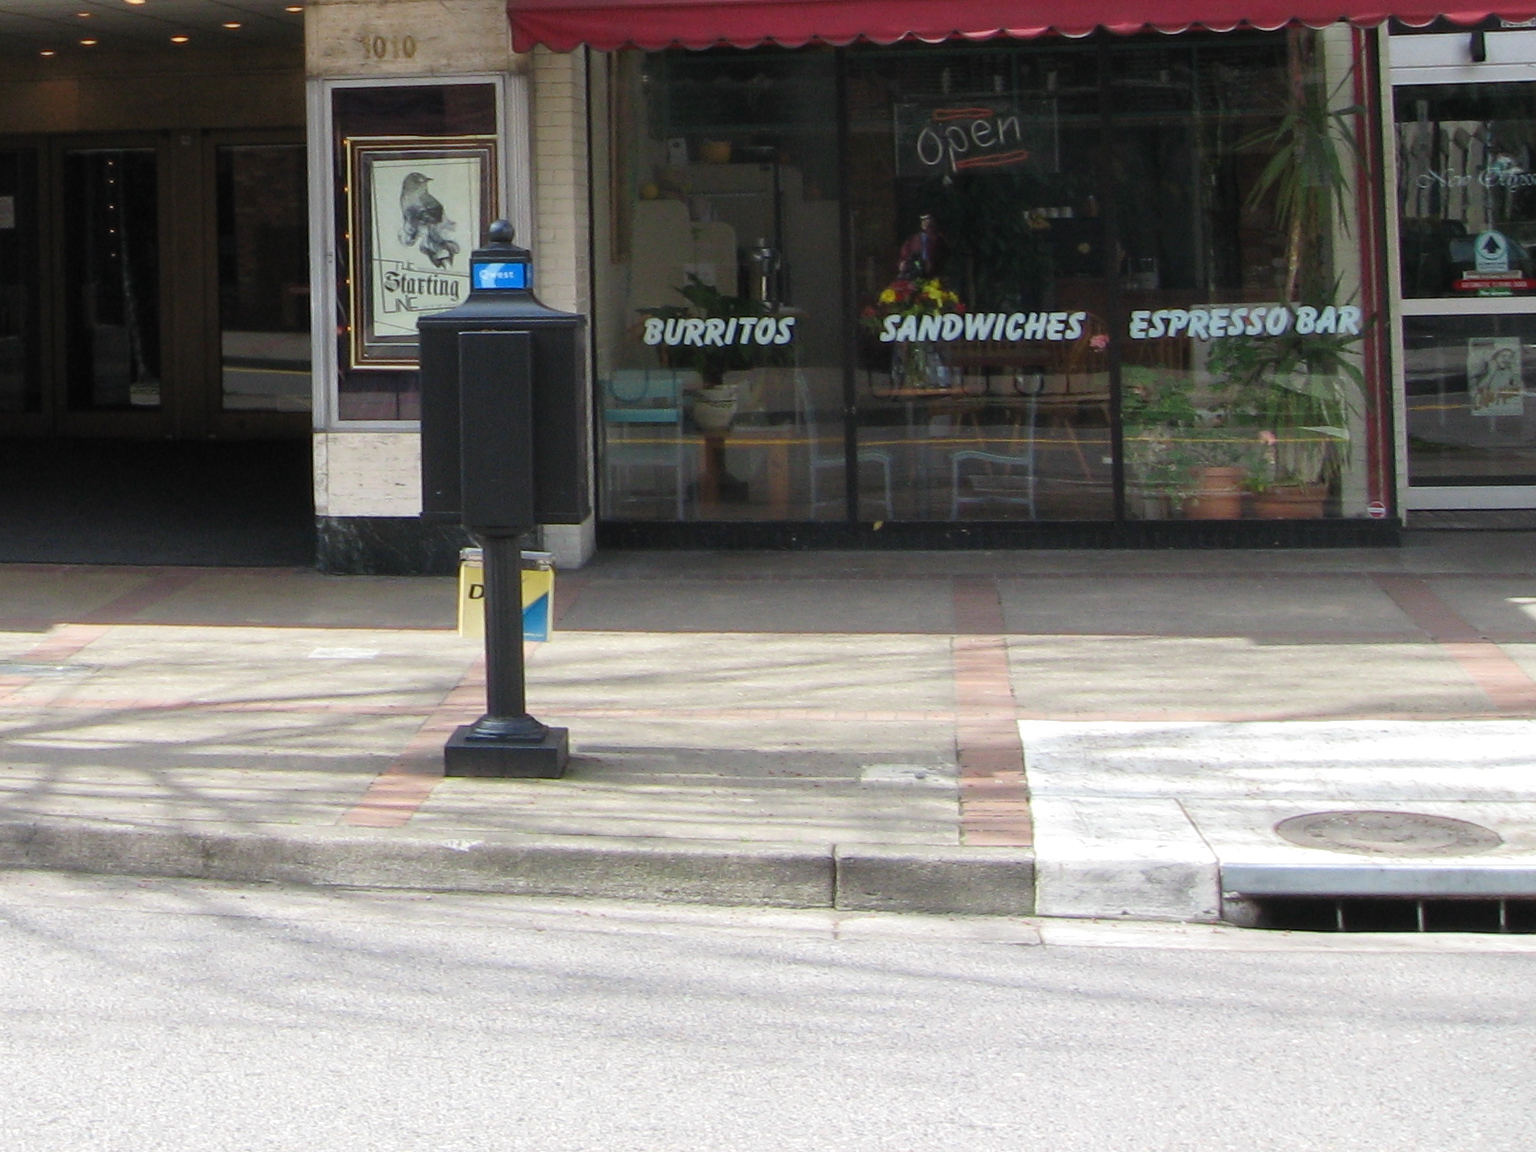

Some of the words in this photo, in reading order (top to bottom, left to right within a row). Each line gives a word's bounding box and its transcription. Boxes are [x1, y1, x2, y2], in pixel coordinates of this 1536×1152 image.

[917, 116, 1022, 173] Open
[384, 270, 460, 302] Starting
[478, 268, 515, 280] Qwest
[643, 316, 796, 348] BURRITOS
[879, 311, 1088, 343] SANDWICHES
[1129, 306, 1290, 340] ESPRESSO
[1295, 305, 1361, 336] BAR
